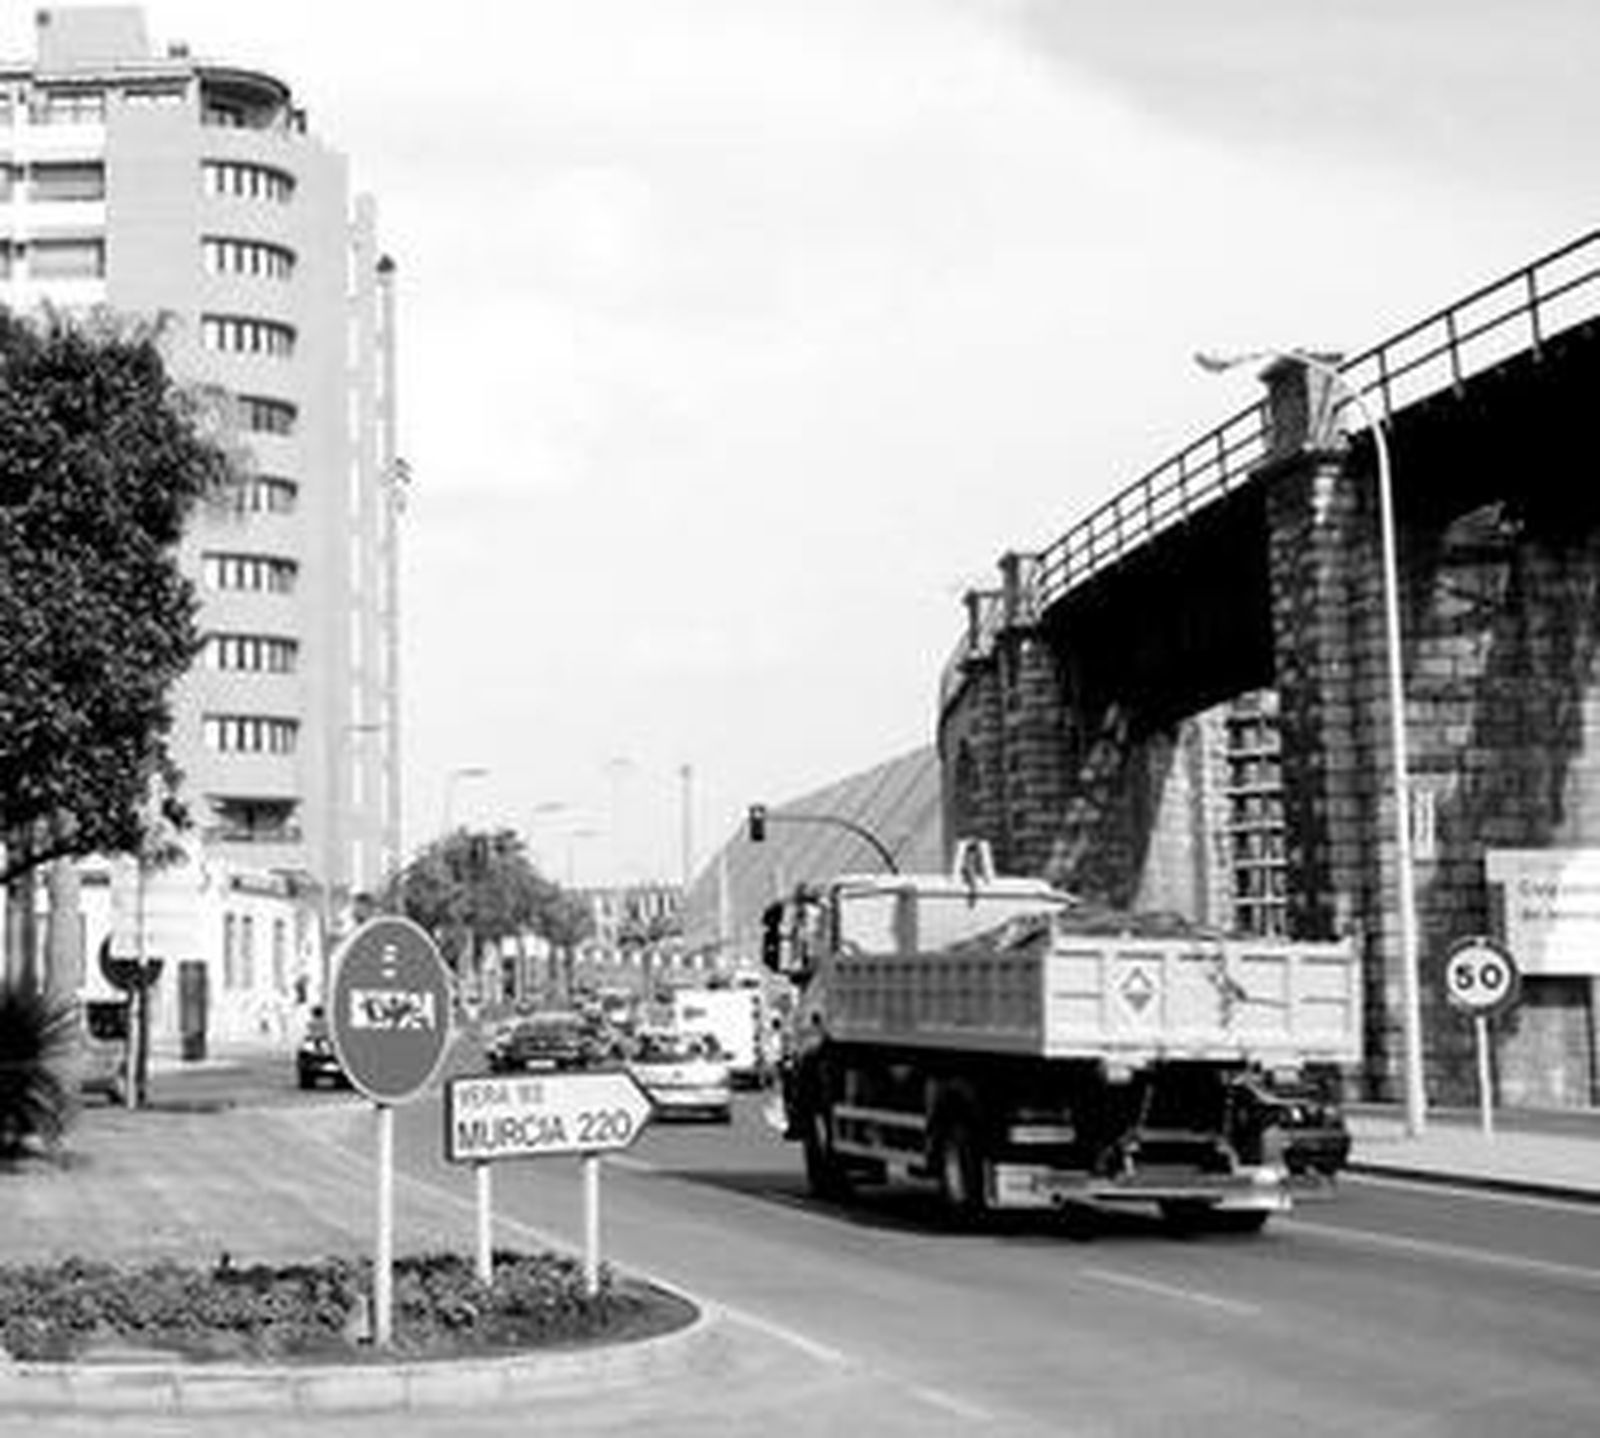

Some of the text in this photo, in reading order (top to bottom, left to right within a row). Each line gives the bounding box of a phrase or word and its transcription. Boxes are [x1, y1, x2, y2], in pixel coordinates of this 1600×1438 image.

[1456, 963, 1504, 990] 50
[458, 1108, 631, 1149] MURCIA 220
